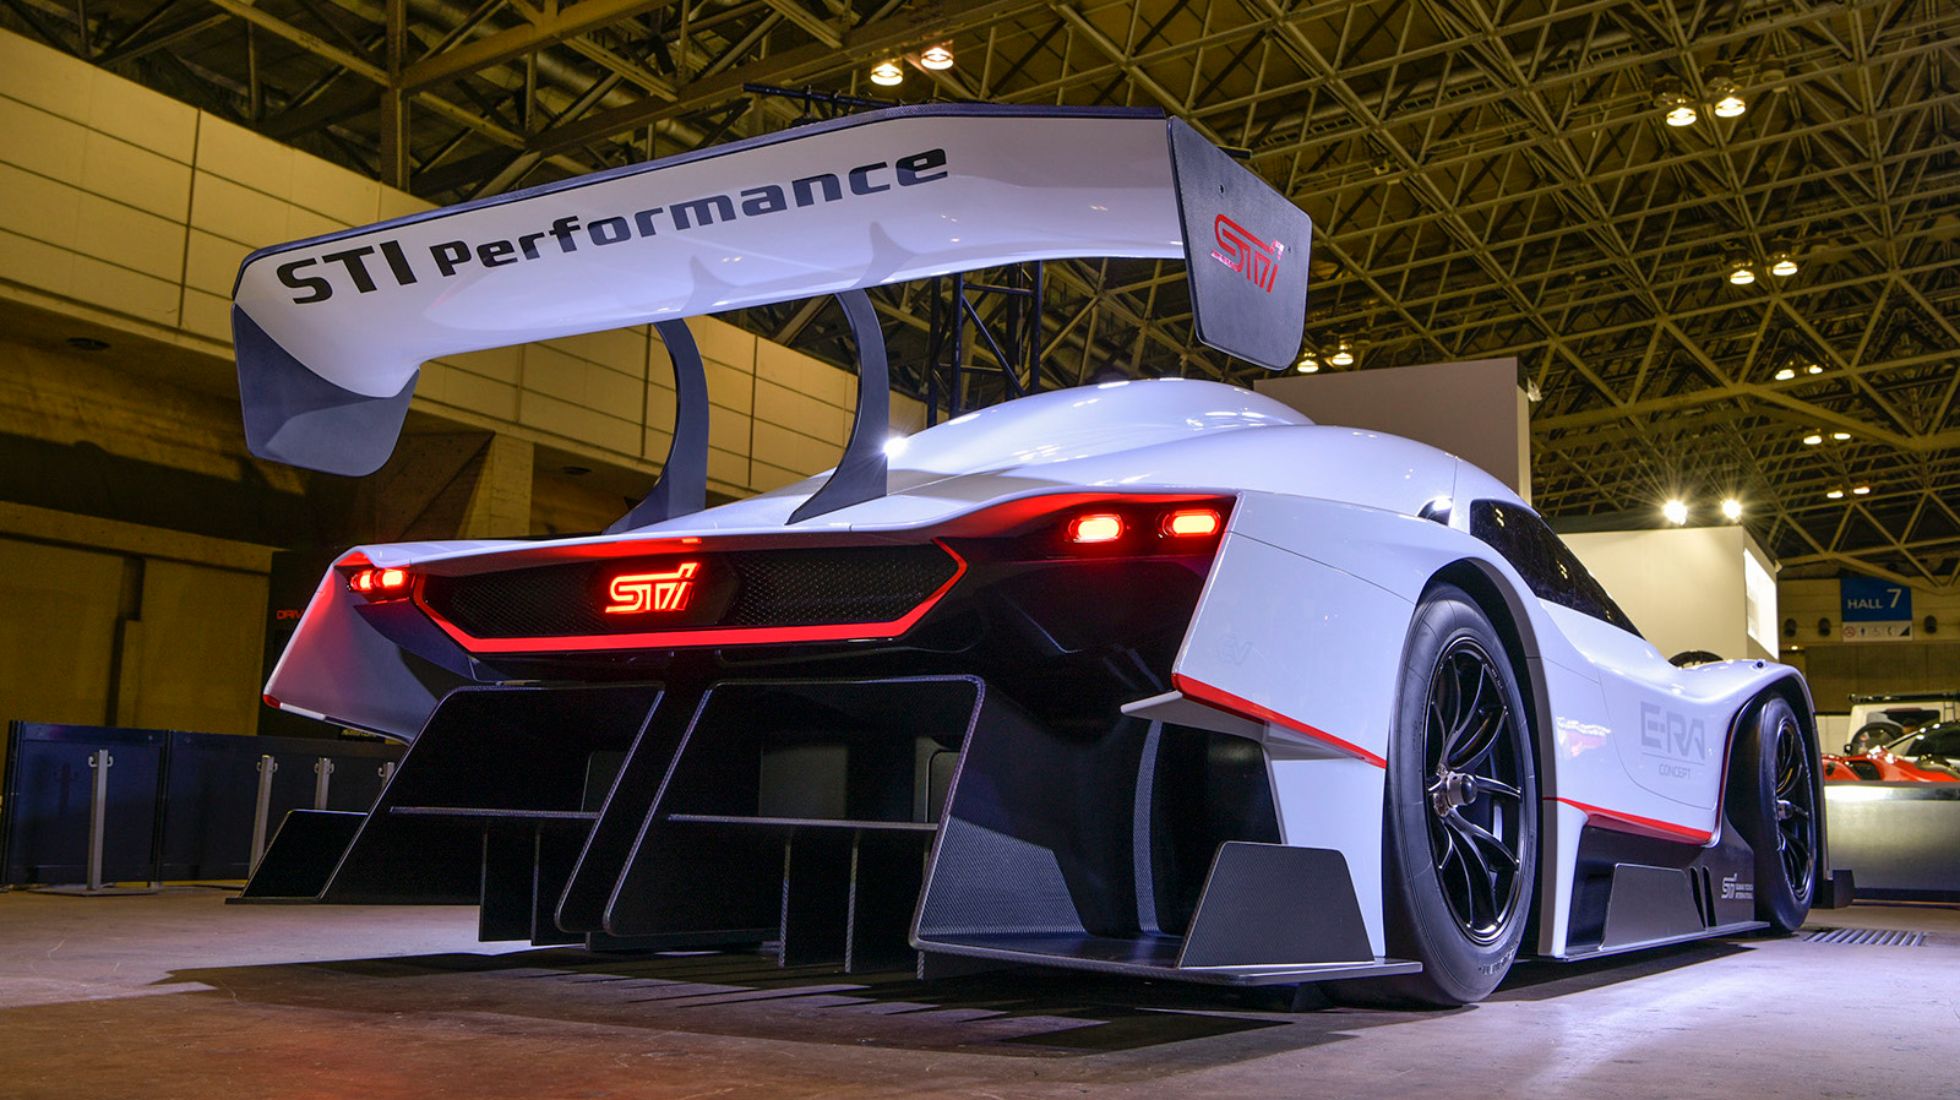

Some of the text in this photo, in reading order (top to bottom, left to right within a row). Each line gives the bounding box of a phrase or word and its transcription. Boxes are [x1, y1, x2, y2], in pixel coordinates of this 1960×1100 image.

[276, 147, 948, 304] STI Performance
[1847, 588, 1902, 609] HALL 7
[1658, 763, 1691, 780] CONCEPT
